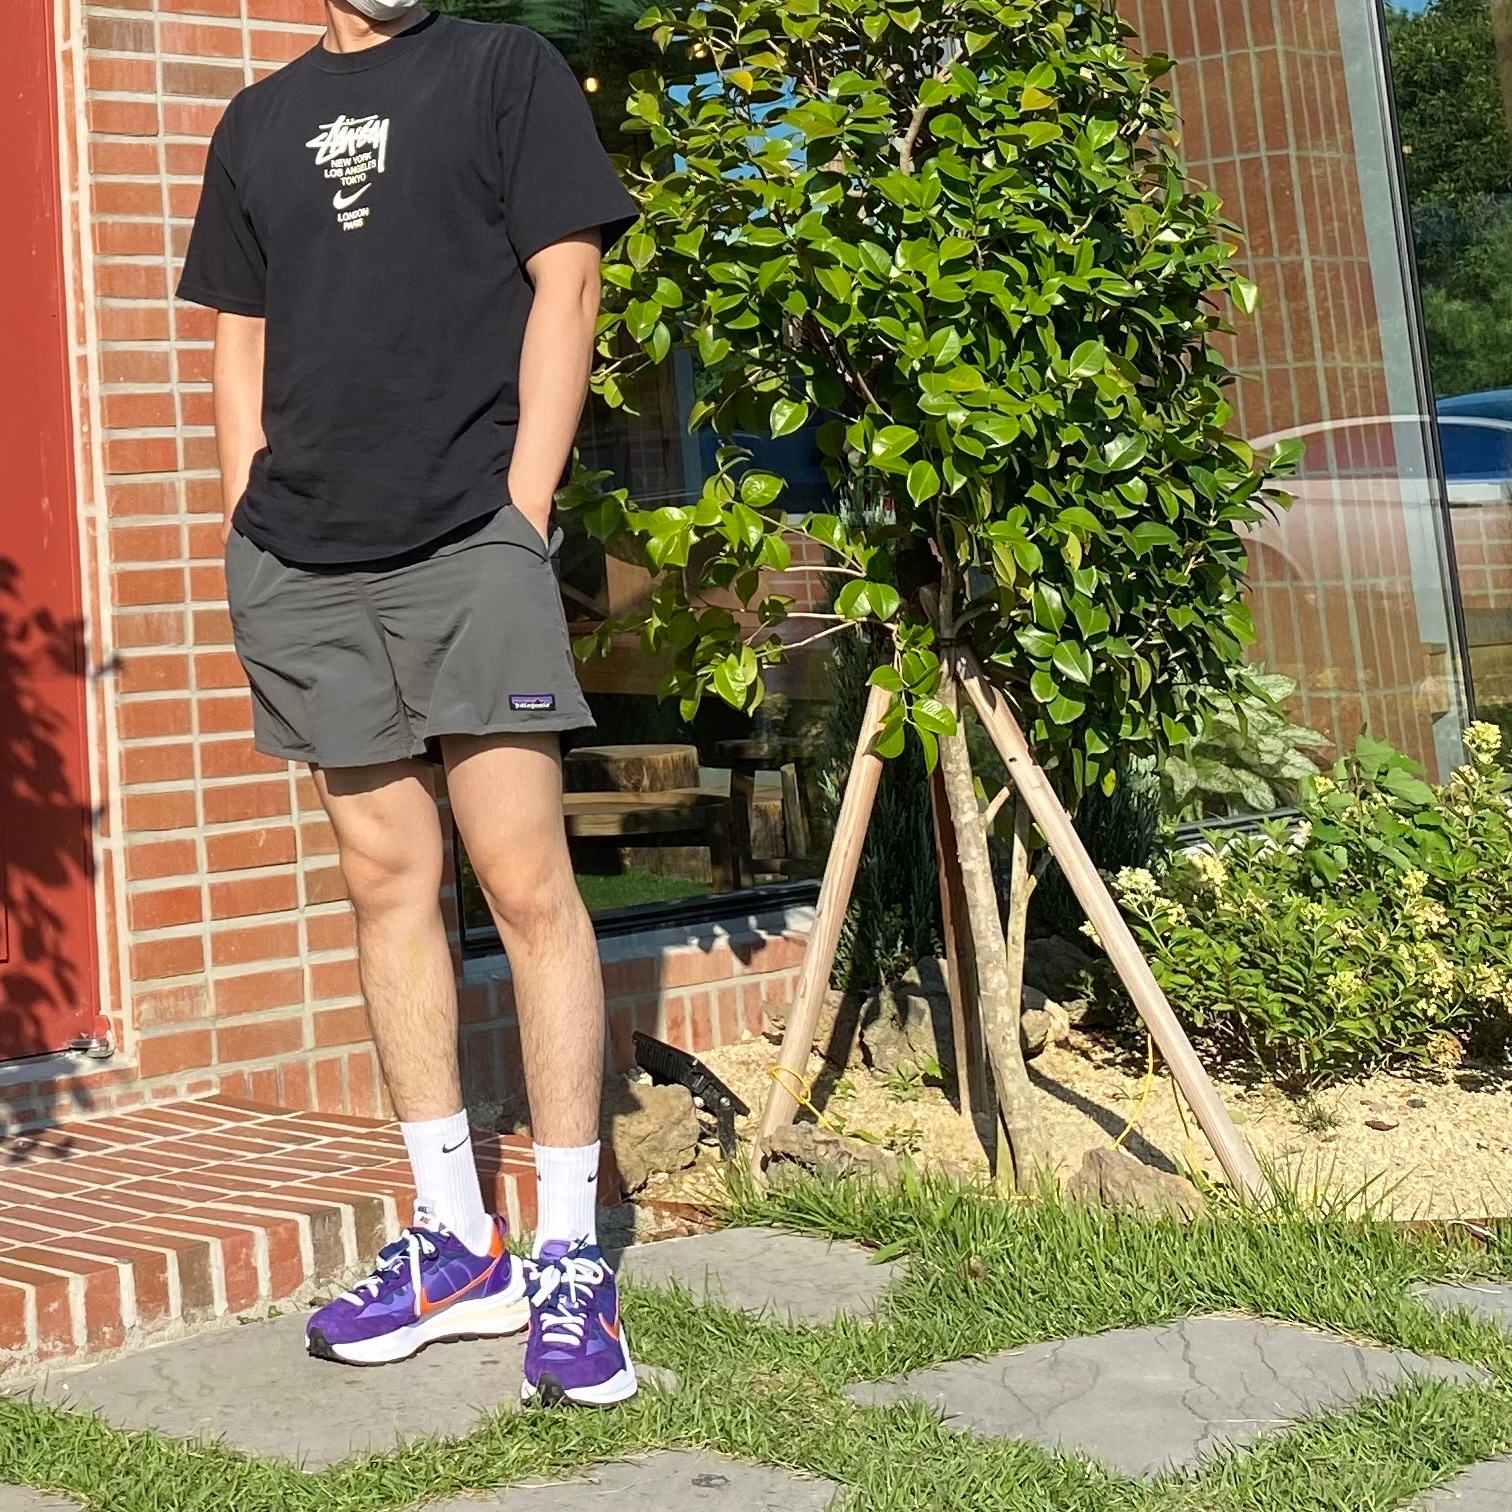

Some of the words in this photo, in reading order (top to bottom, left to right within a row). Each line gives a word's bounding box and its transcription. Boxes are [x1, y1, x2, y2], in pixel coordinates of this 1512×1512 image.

[331, 157, 352, 168] NEW
[353, 151, 372, 164] YORK
[324, 168, 344, 178] LOS
[345, 159, 377, 175] ANGELES
[340, 173, 366, 186] TOKYO
[337, 207, 369, 222] LONDON
